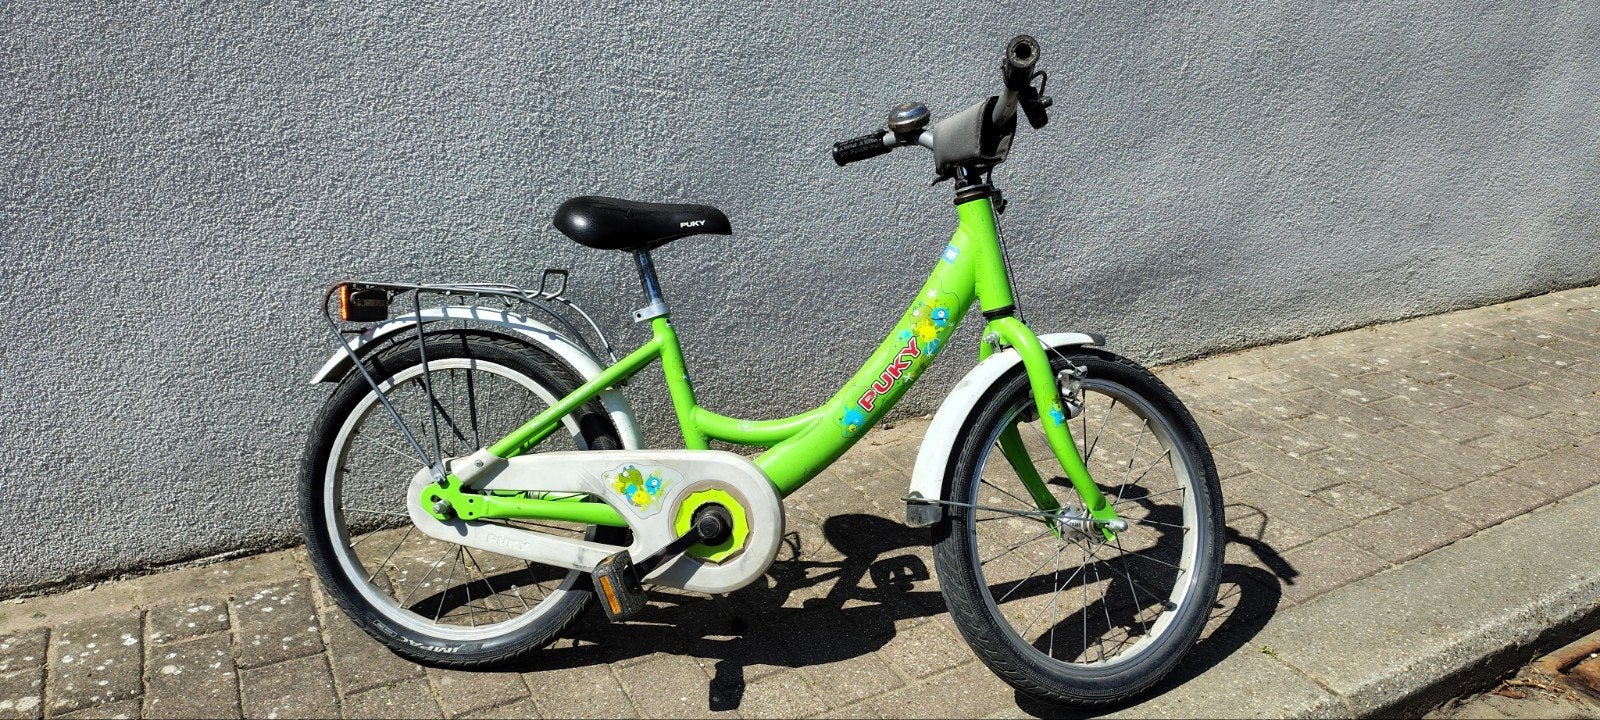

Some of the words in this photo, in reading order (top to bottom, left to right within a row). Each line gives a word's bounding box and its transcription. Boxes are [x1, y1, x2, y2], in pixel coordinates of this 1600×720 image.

[680, 220, 706, 228] PUKY
[858, 336, 920, 412] PUKY
[398, 635, 460, 654] IMPAC
